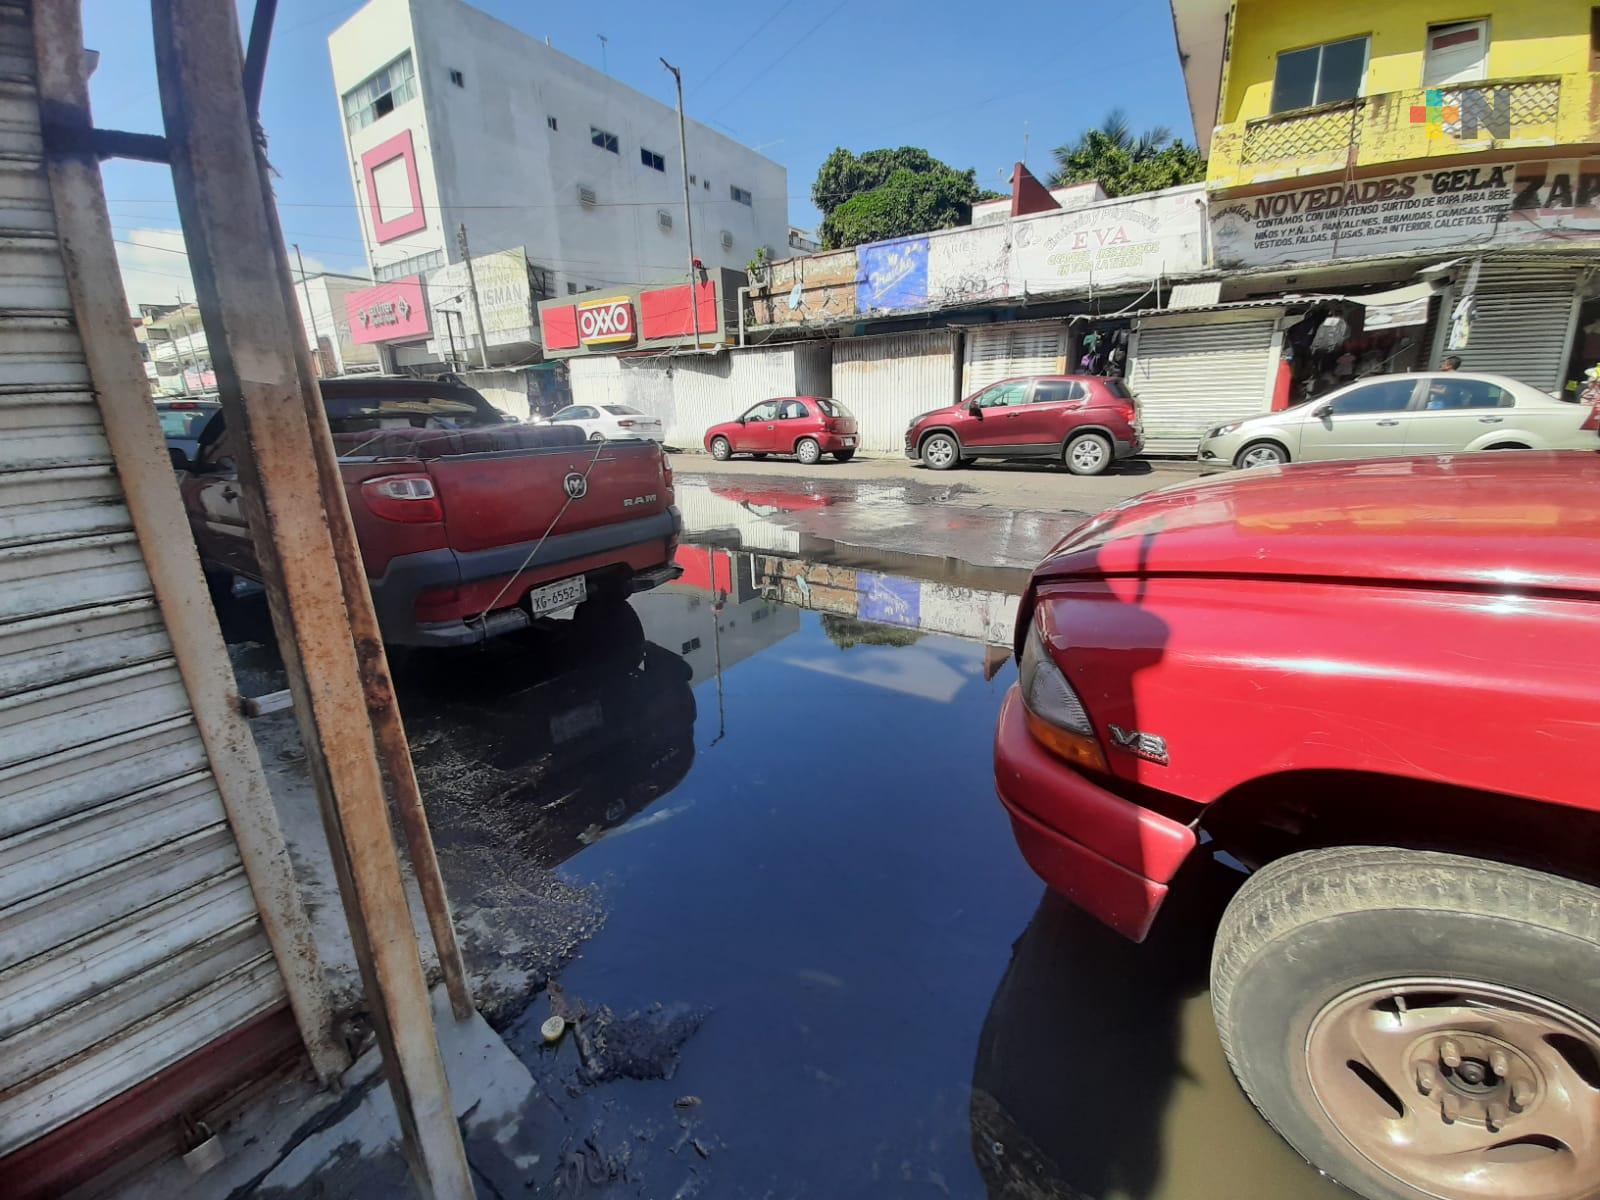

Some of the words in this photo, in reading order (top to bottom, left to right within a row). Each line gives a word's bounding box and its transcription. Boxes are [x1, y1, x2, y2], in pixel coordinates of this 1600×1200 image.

[1254, 176, 1418, 219] NOVEDADES
[1256, 214, 1303, 228] CONTAMOS
[1306, 211, 1324, 222] CON
[1325, 209, 1338, 220] UN
[1340, 204, 1378, 217] EXTENSO
[1381, 200, 1420, 212] SURTIDO
[1422, 197, 1435, 208] DE
[1437, 194, 1461, 206] ROPA
[1461, 192, 1485, 203] PARA
[1072, 226, 1131, 250] EVA
[1280, 227, 1287, 237] Y
[580, 304, 629, 337] OXXO
[623, 494, 657, 507] RAM
[534, 583, 585, 611] XG-6552-A
[1110, 724, 1167, 755] V8
